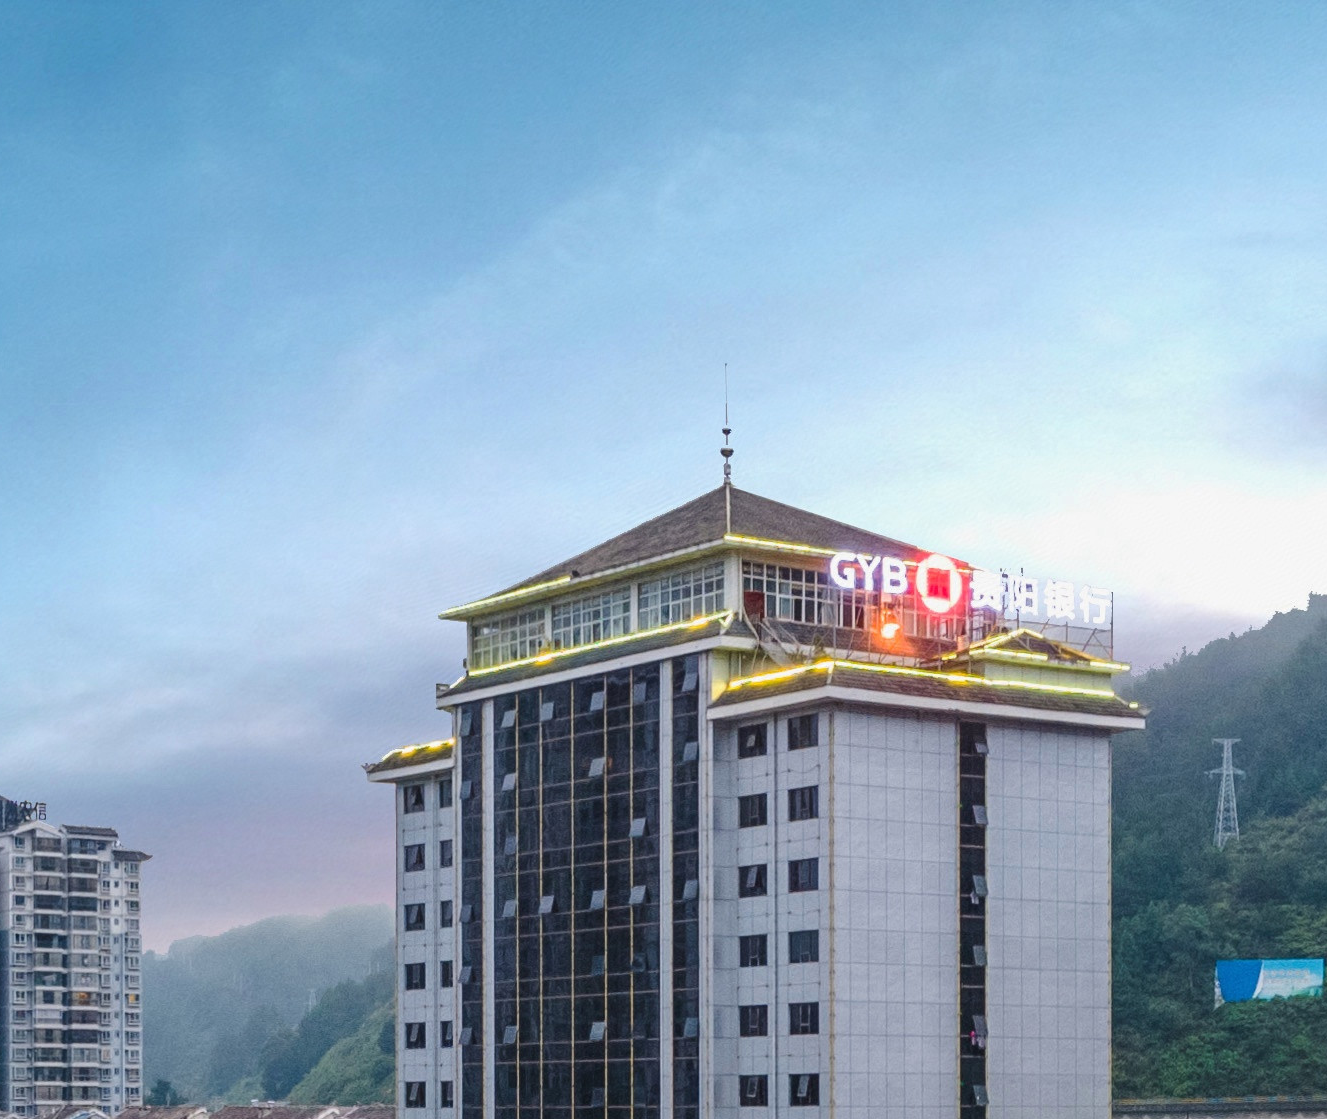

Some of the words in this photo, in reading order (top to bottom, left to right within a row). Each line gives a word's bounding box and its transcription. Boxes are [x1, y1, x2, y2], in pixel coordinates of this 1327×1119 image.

[829, 551, 909, 594] GYB
[969, 569, 1113, 624] 贵阳银行
